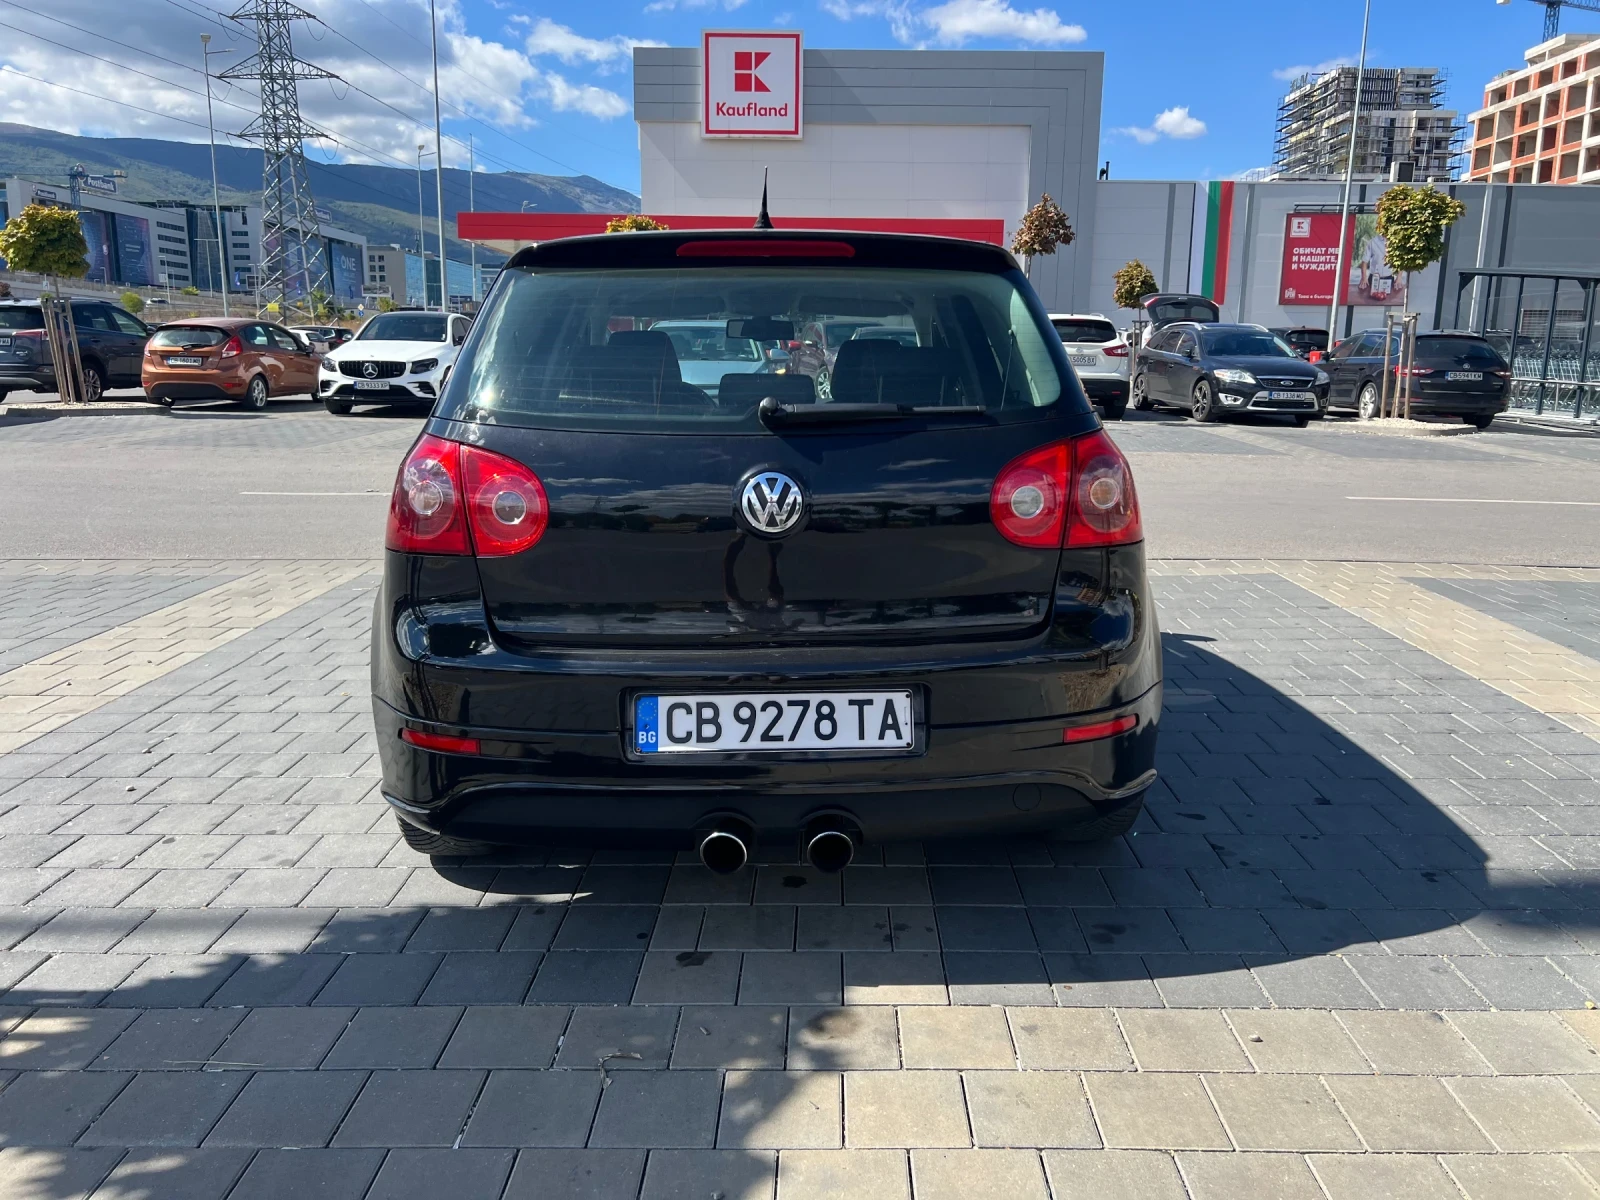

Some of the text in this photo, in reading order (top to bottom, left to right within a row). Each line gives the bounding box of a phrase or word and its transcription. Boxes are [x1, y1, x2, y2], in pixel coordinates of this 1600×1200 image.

[716, 102, 788, 116] Kaufland
[88, 177, 114, 191] Postbank
[341, 256, 356, 270] ONE
[1300, 256, 1338, 264] НАШИТЕ,
[666, 698, 904, 744] CB 9278 TA
[638, 732, 656, 744] BG
